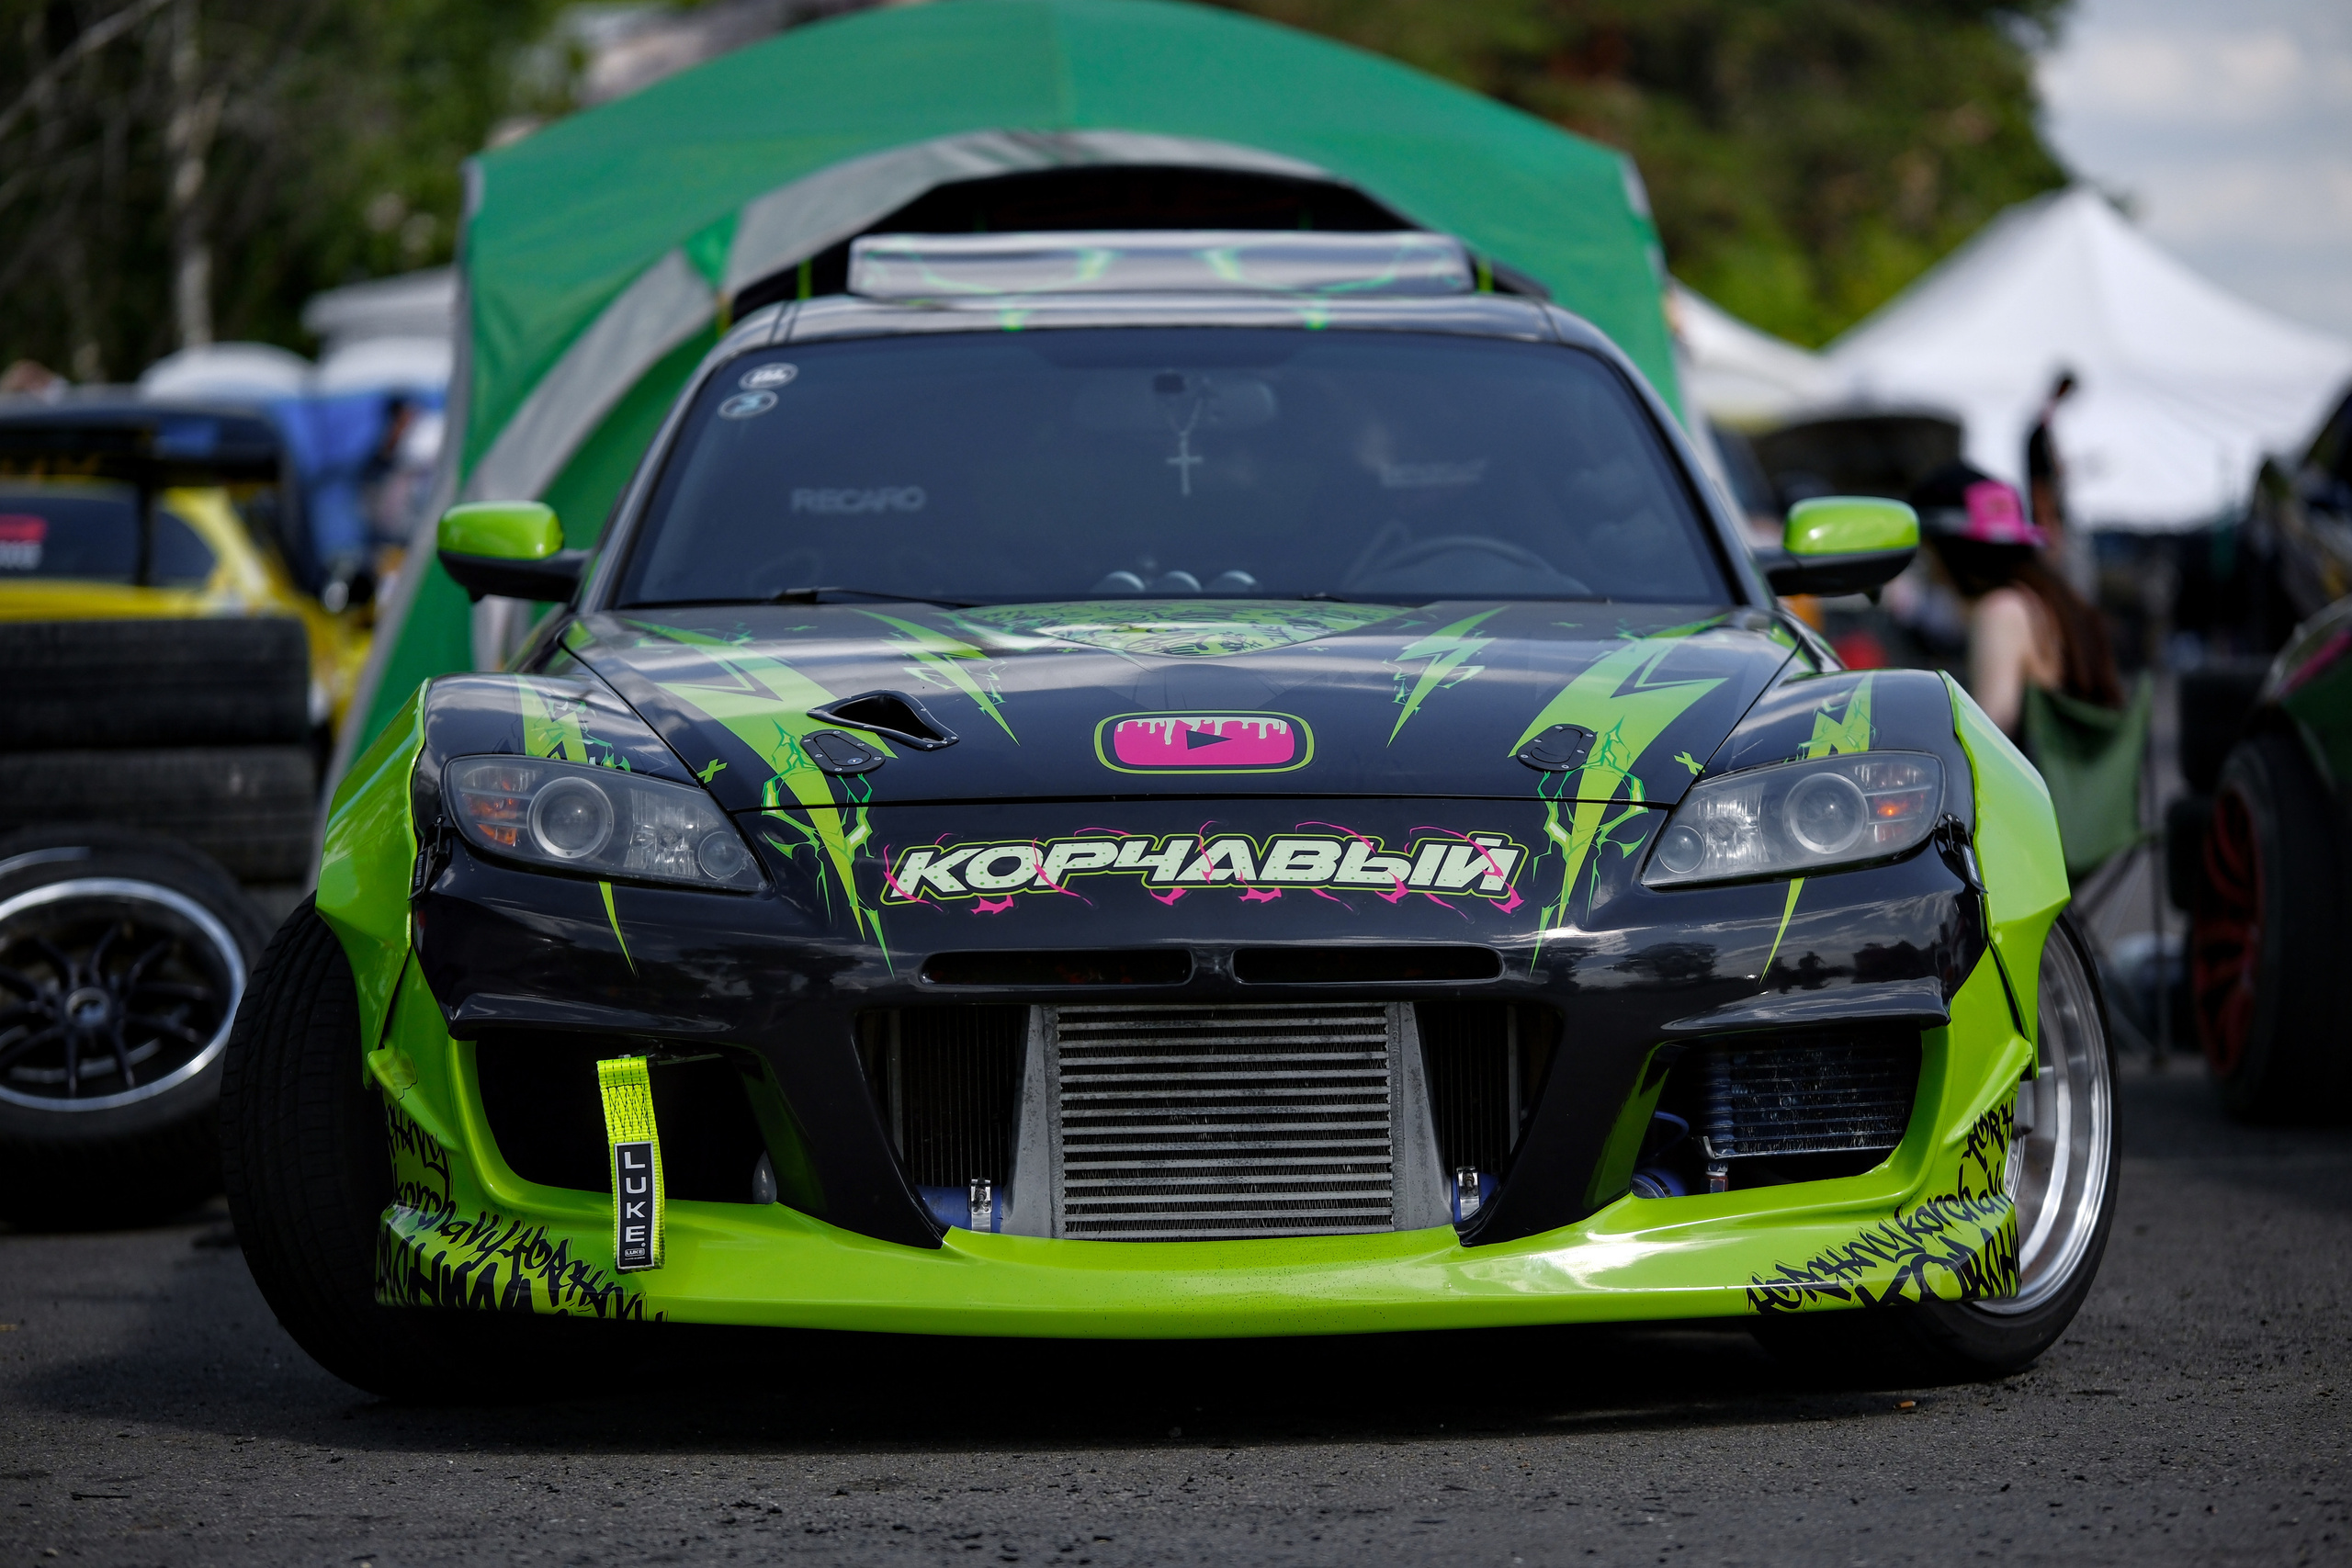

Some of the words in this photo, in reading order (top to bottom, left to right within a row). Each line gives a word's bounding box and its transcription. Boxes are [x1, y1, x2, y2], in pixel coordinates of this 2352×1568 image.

[791, 485, 926, 515] RECARO
[886, 834, 1522, 901] КОРЧАВЫЙ
[624, 1151, 647, 1243] LUKE
